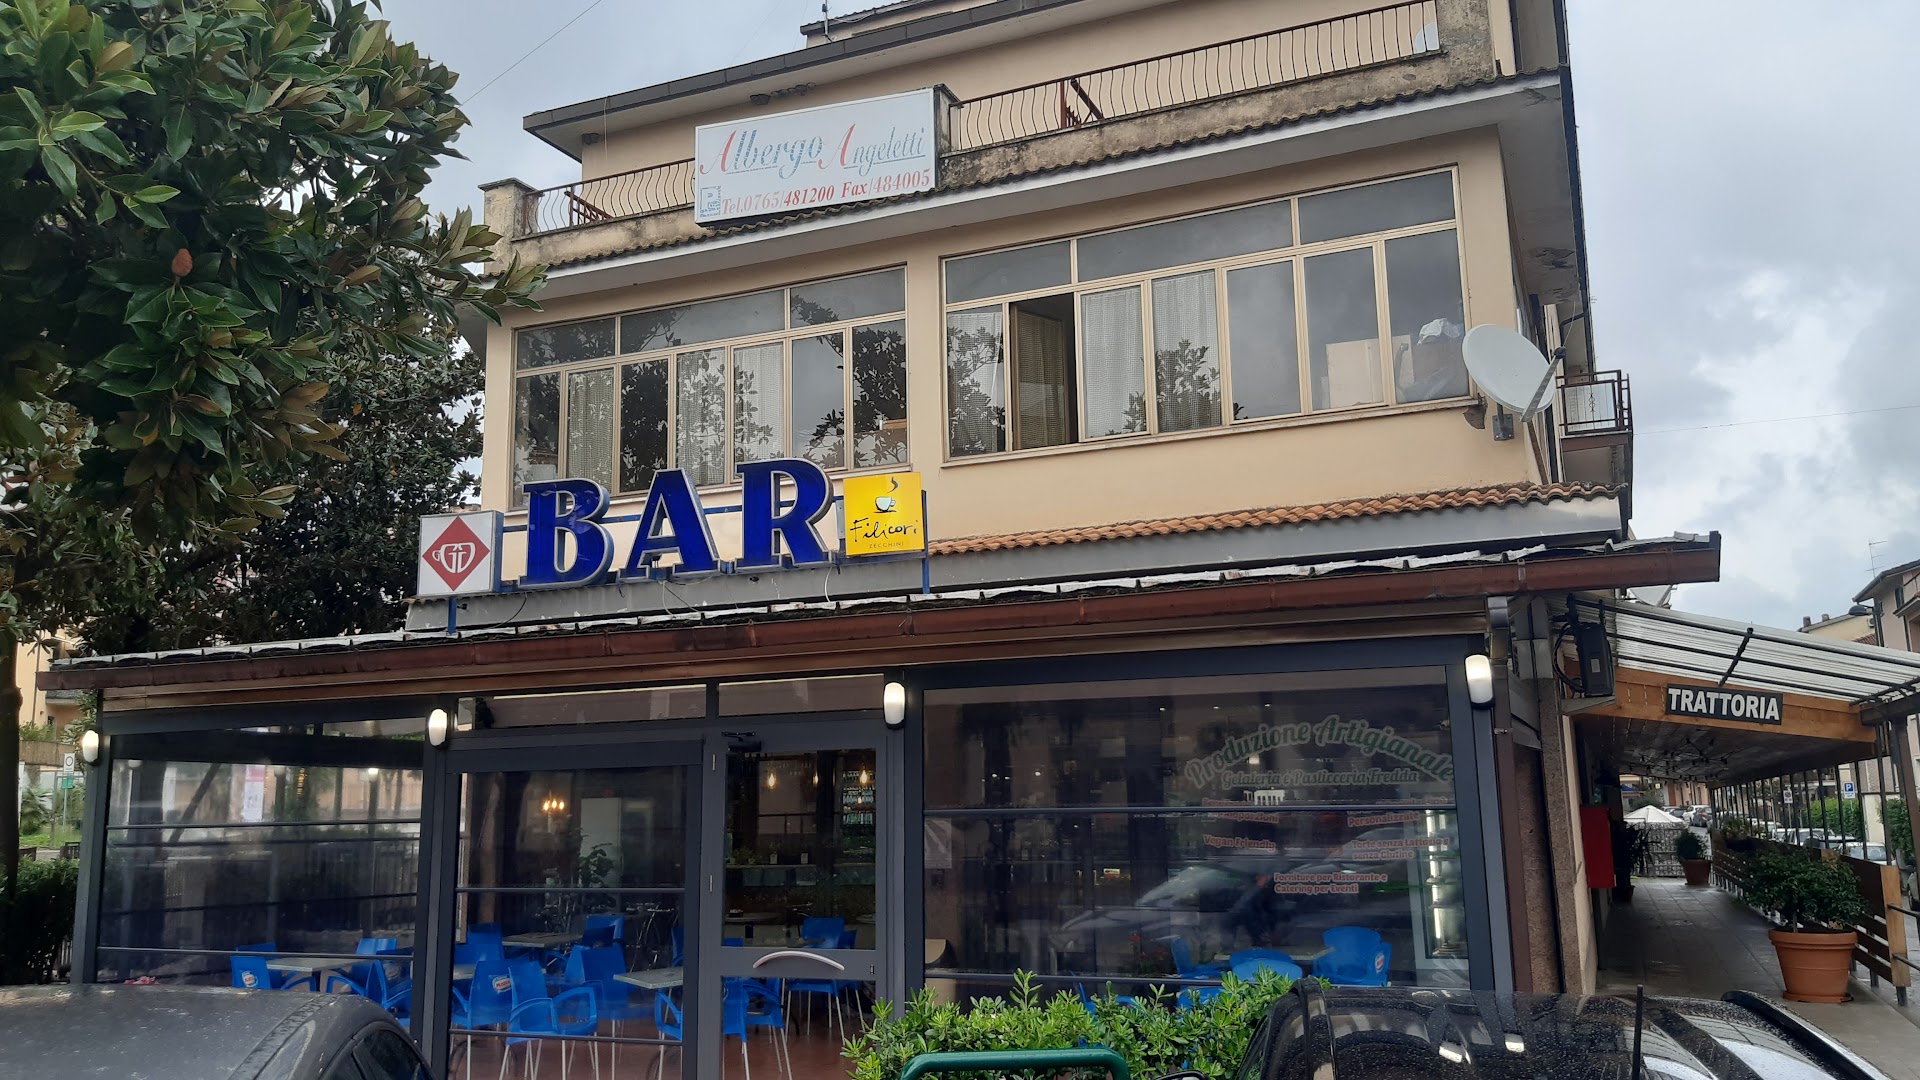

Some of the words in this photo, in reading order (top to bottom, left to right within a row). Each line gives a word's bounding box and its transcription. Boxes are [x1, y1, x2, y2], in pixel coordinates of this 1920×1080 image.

[700, 129, 824, 180] Albergo
[818, 123, 926, 177] Angeletti
[840, 168, 931, 199] Fax/484005
[519, 458, 840, 590] BAR
[849, 517, 919, 543] Filicori
[869, 541, 905, 549] ZECCHINI
[1668, 687, 1780, 721] TRATTORIA
[1185, 722, 1311, 788] Produzione
[1313, 714, 1453, 783] Artigianale
[1293, 768, 1366, 785] Pasticceria
[1367, 767, 1419, 784] Fredda
[1348, 812, 1420, 827] Personalizzate
[1203, 835, 1234, 847] Vegan
[1235, 838, 1276, 852] Friendly
[1352, 841, 1377, 849] Torte
[1378, 840, 1404, 848] senza
[1353, 852, 1379, 860] senza
[1380, 850, 1414, 860] Glutine
[1274, 873, 1316, 882] Forniture
[1316, 874, 1332, 884] per
[1333, 872, 1380, 882] Ristorante
[1275, 884, 1313, 895] Catering
[1314, 885, 1330, 895] per
[1331, 884, 1359, 893] Eventi
